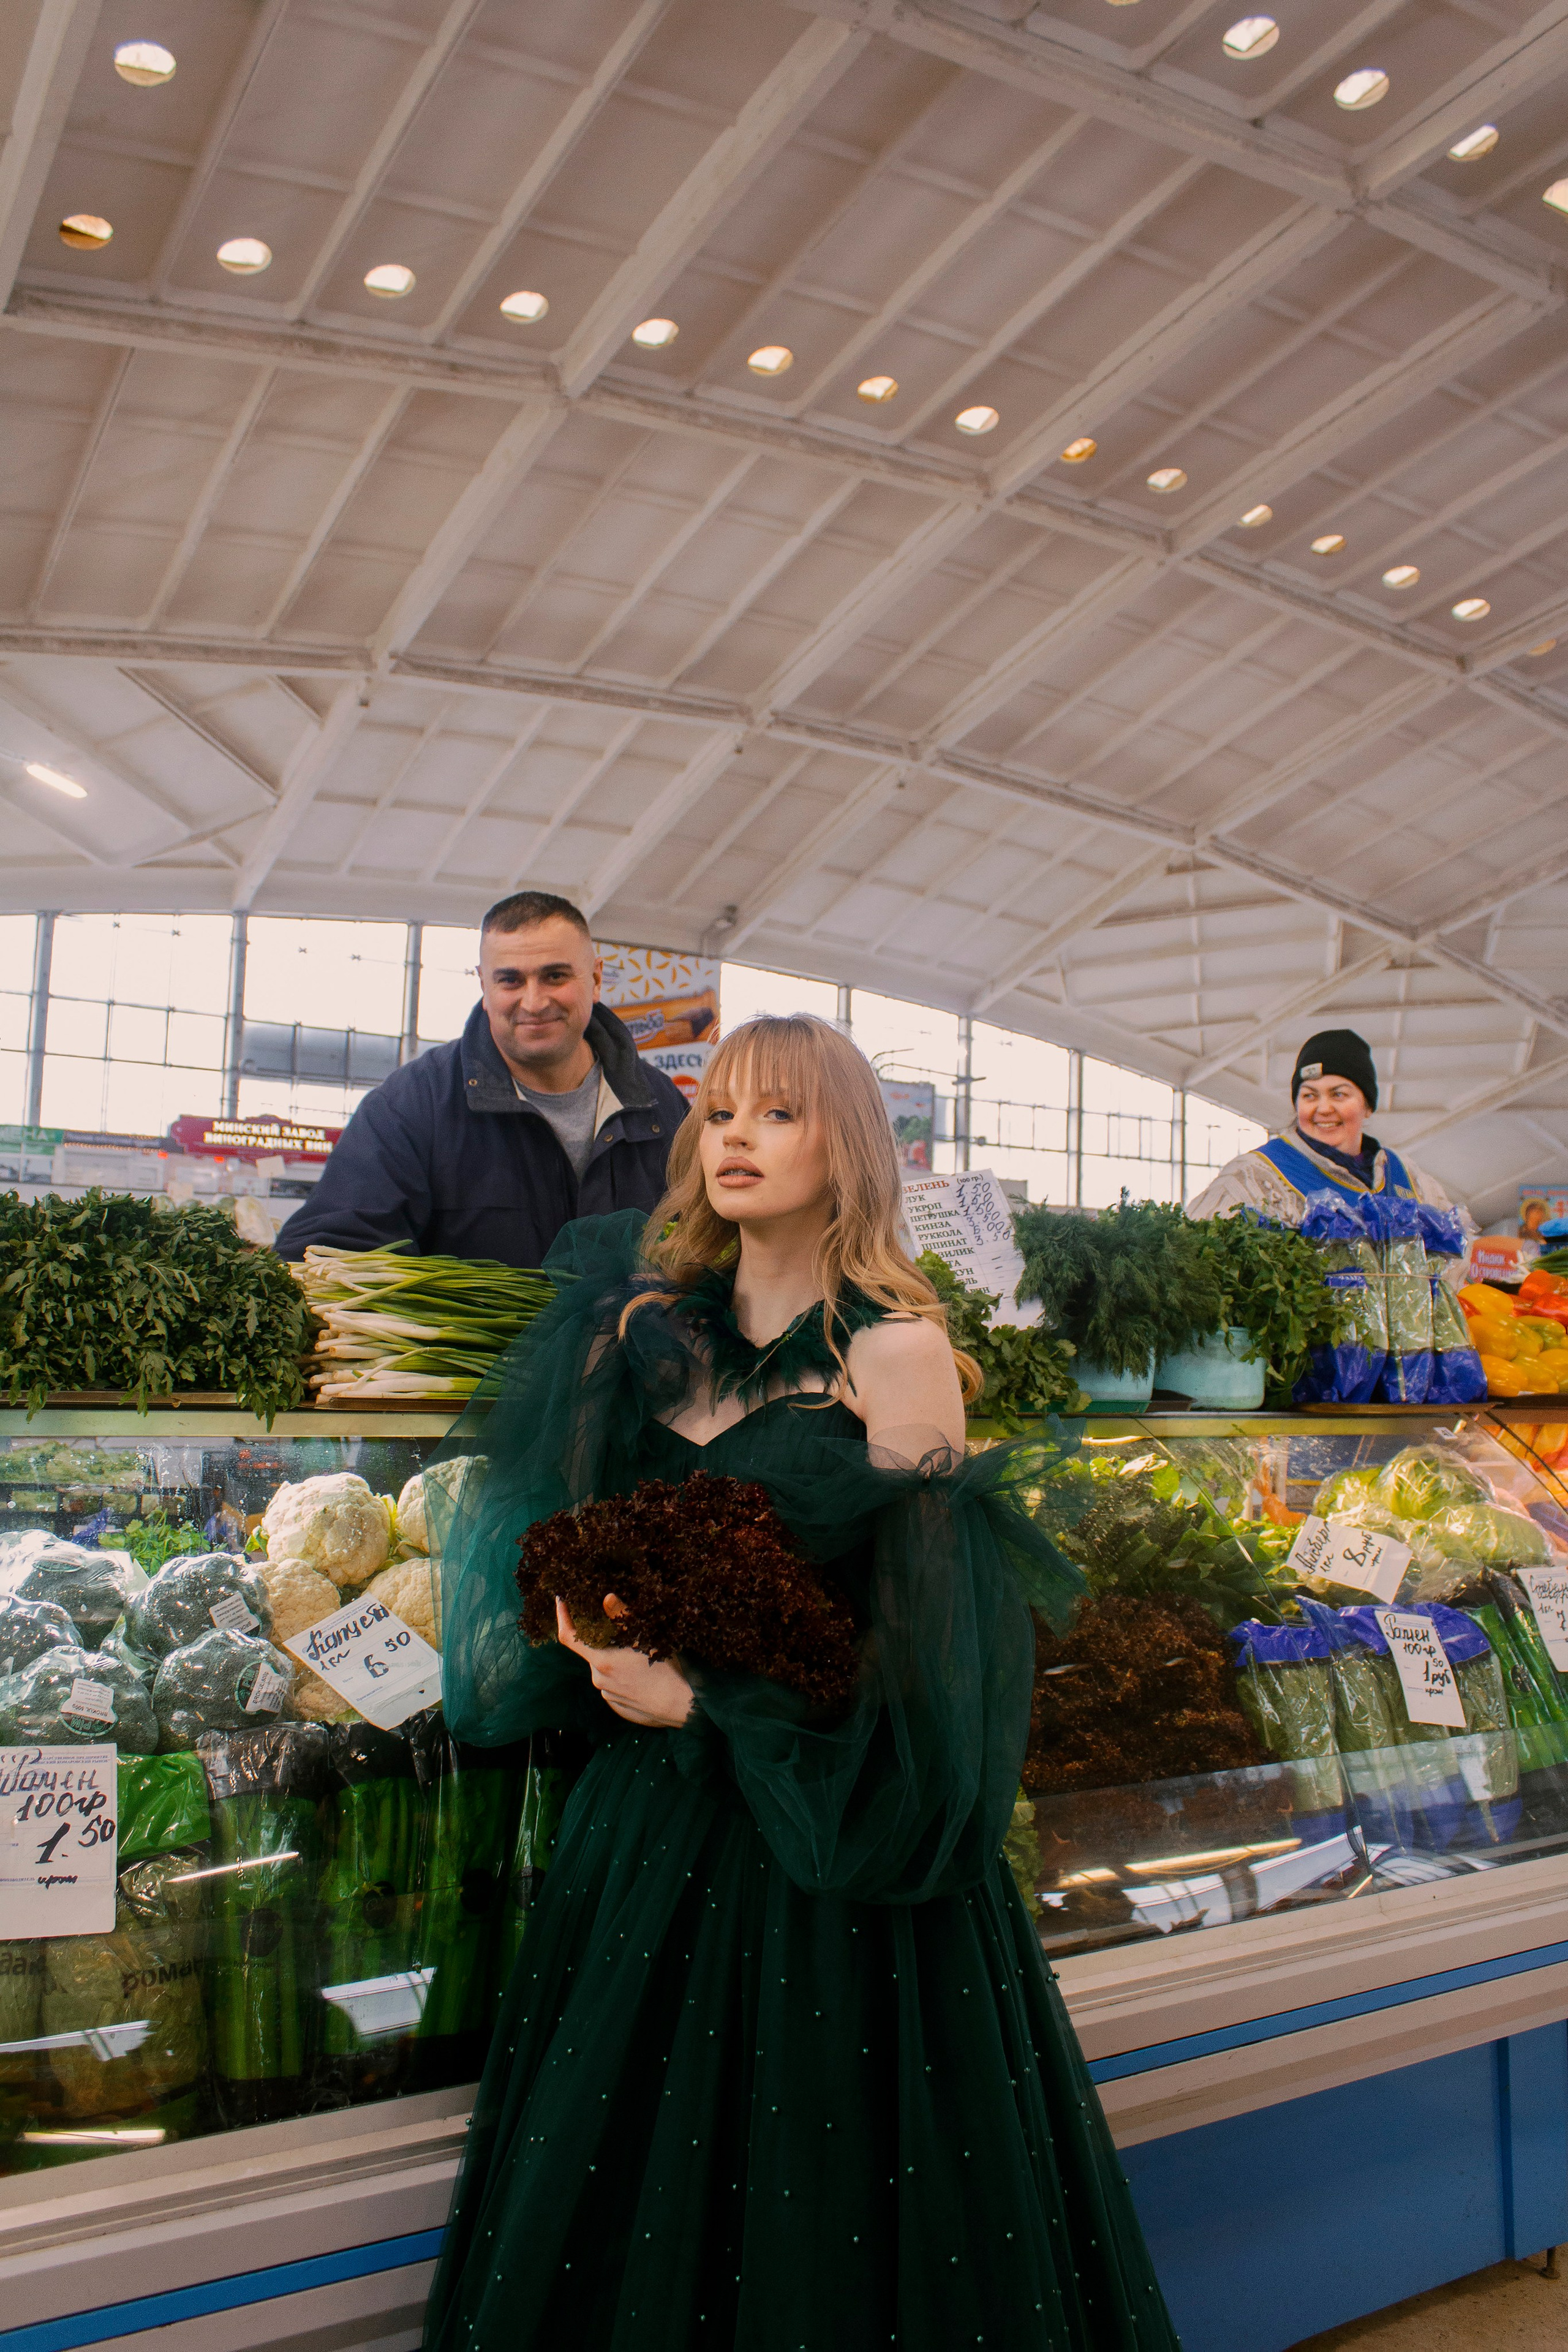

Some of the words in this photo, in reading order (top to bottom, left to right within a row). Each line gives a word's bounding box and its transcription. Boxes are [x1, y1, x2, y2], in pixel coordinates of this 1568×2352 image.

[213, 1121, 281, 1136] МИНСКИЙ
[282, 1126, 325, 1140] ЗАВОД
[203, 1132, 303, 1150] ВИНОГРАДНЫХ
[304, 1140, 333, 1153] ВИН
[905, 1194, 925, 1204] ЛУК
[908, 1202, 942, 1213] УКРОП
[910, 1209, 960, 1223] ПЕТРУШКА
[914, 1221, 952, 1232] КИНЗА
[919, 1229, 963, 1241] РУККОЛА
[921, 1238, 967, 1250] ШПИНАТ
[938, 1247, 975, 1258] ЗИЛИК
[1343, 1547, 1366, 1567] 8
[364, 1654, 390, 1678] 6
[385, 1631, 411, 1652] 50
[252, 1683, 265, 1704] BROKUL
[86, 1707, 108, 1716] BROKUL
[78, 1814, 116, 1848] 50
